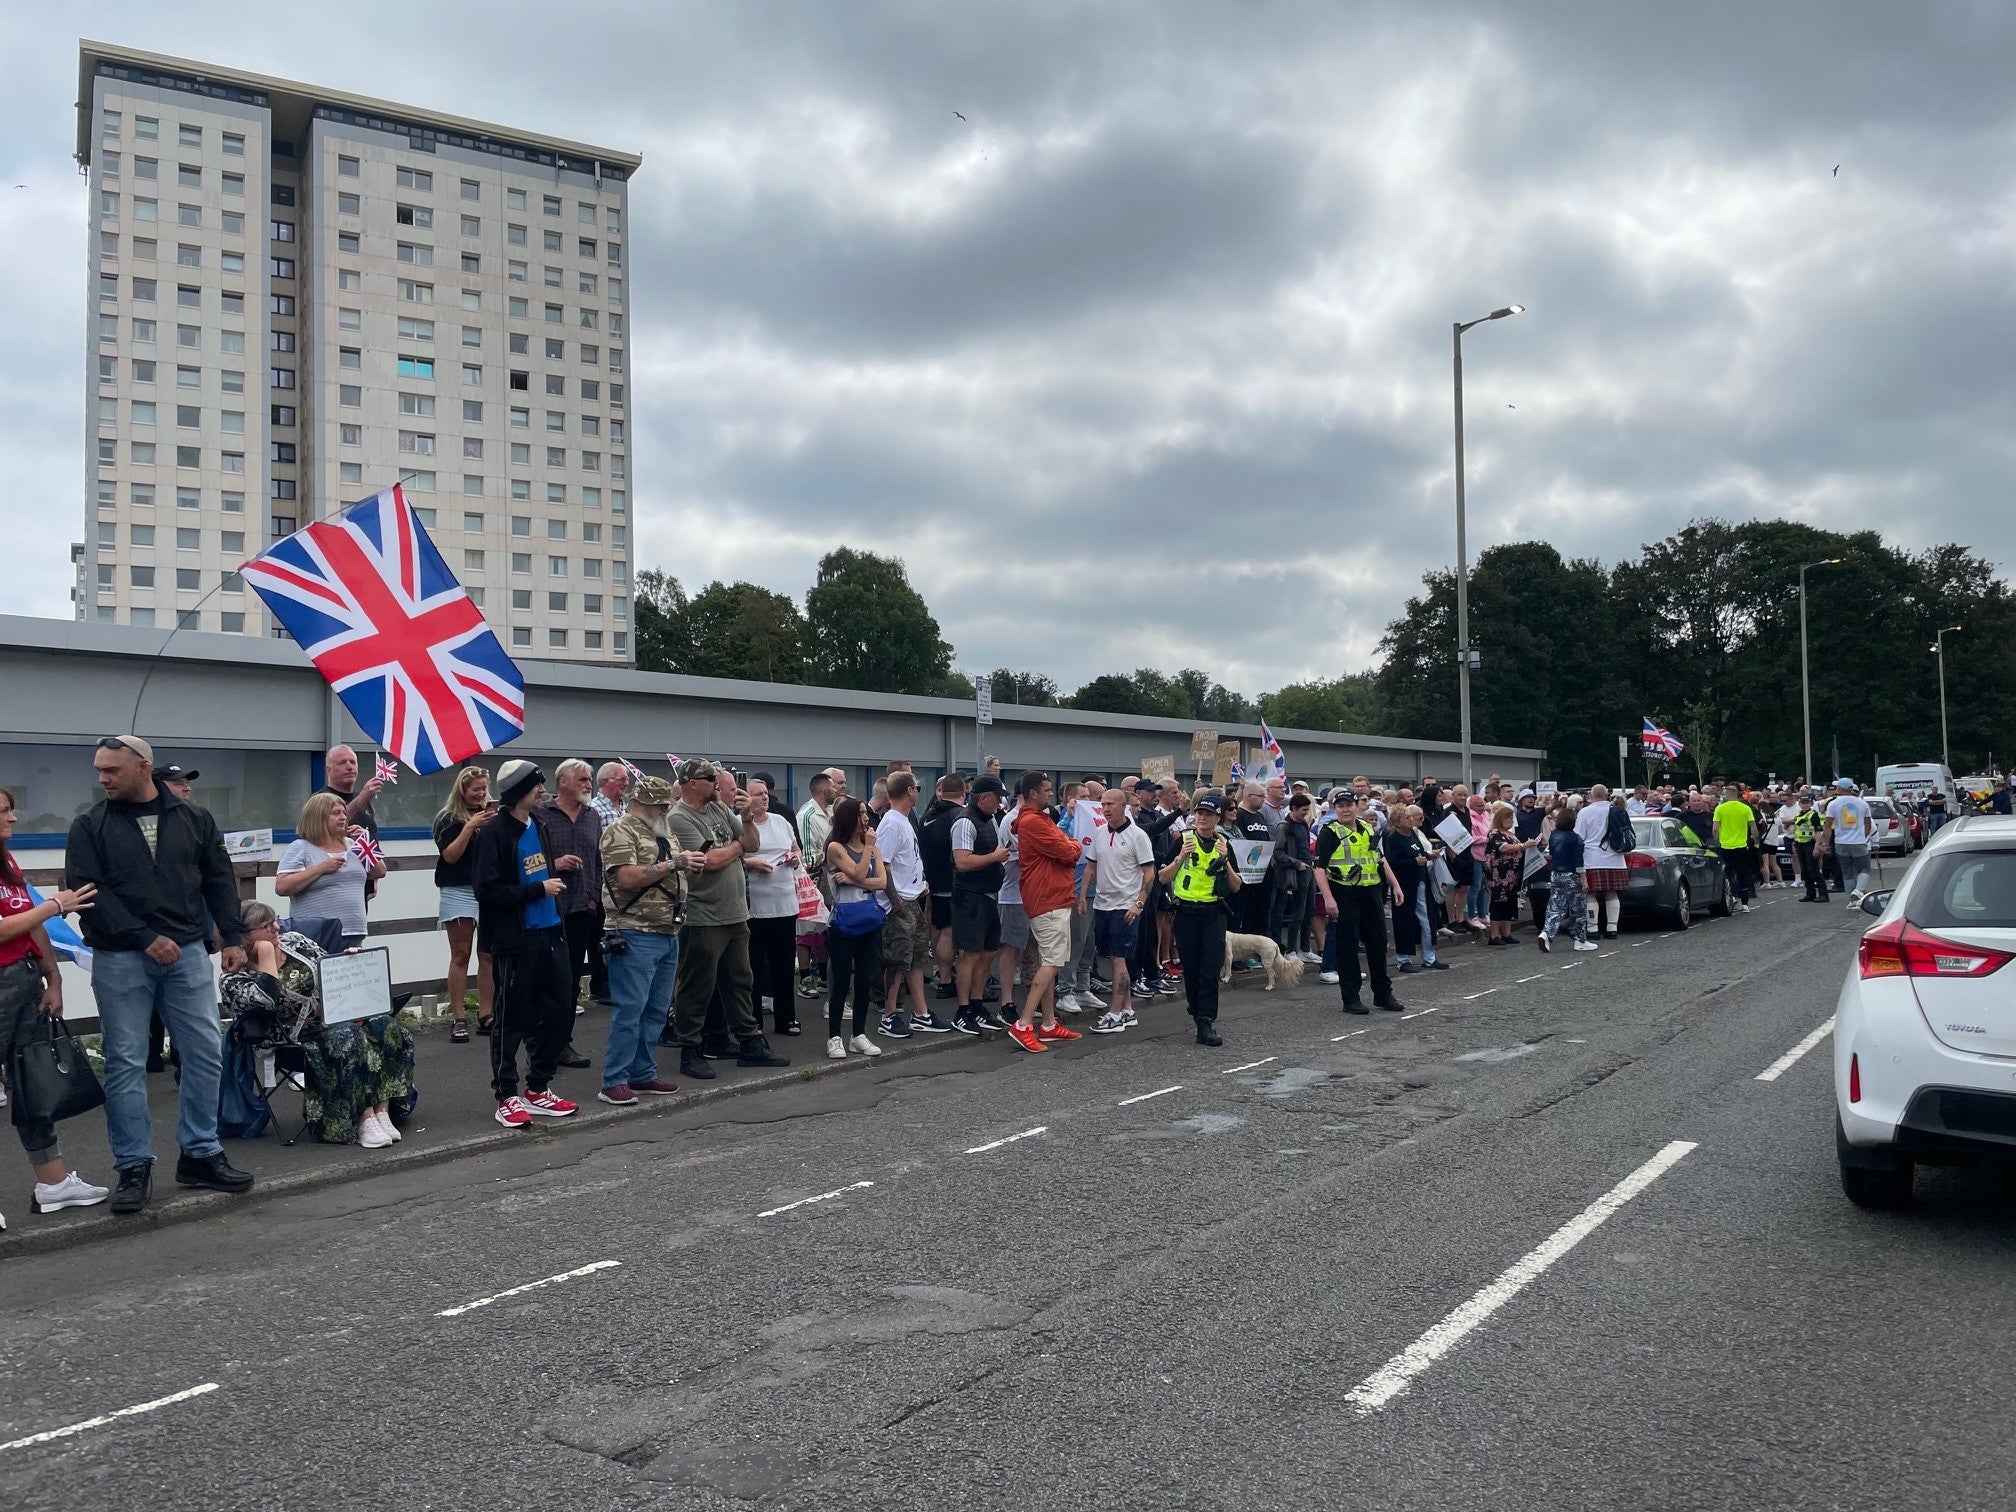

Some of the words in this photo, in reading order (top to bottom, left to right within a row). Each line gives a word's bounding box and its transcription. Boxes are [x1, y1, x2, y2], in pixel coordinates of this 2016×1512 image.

[1195, 730, 1218, 741] ENOUGH
[1192, 750, 1215, 760] ENOUGH
[1142, 758, 1169, 769] WOMEN
[1945, 1024, 1986, 1034] TOYOTA
